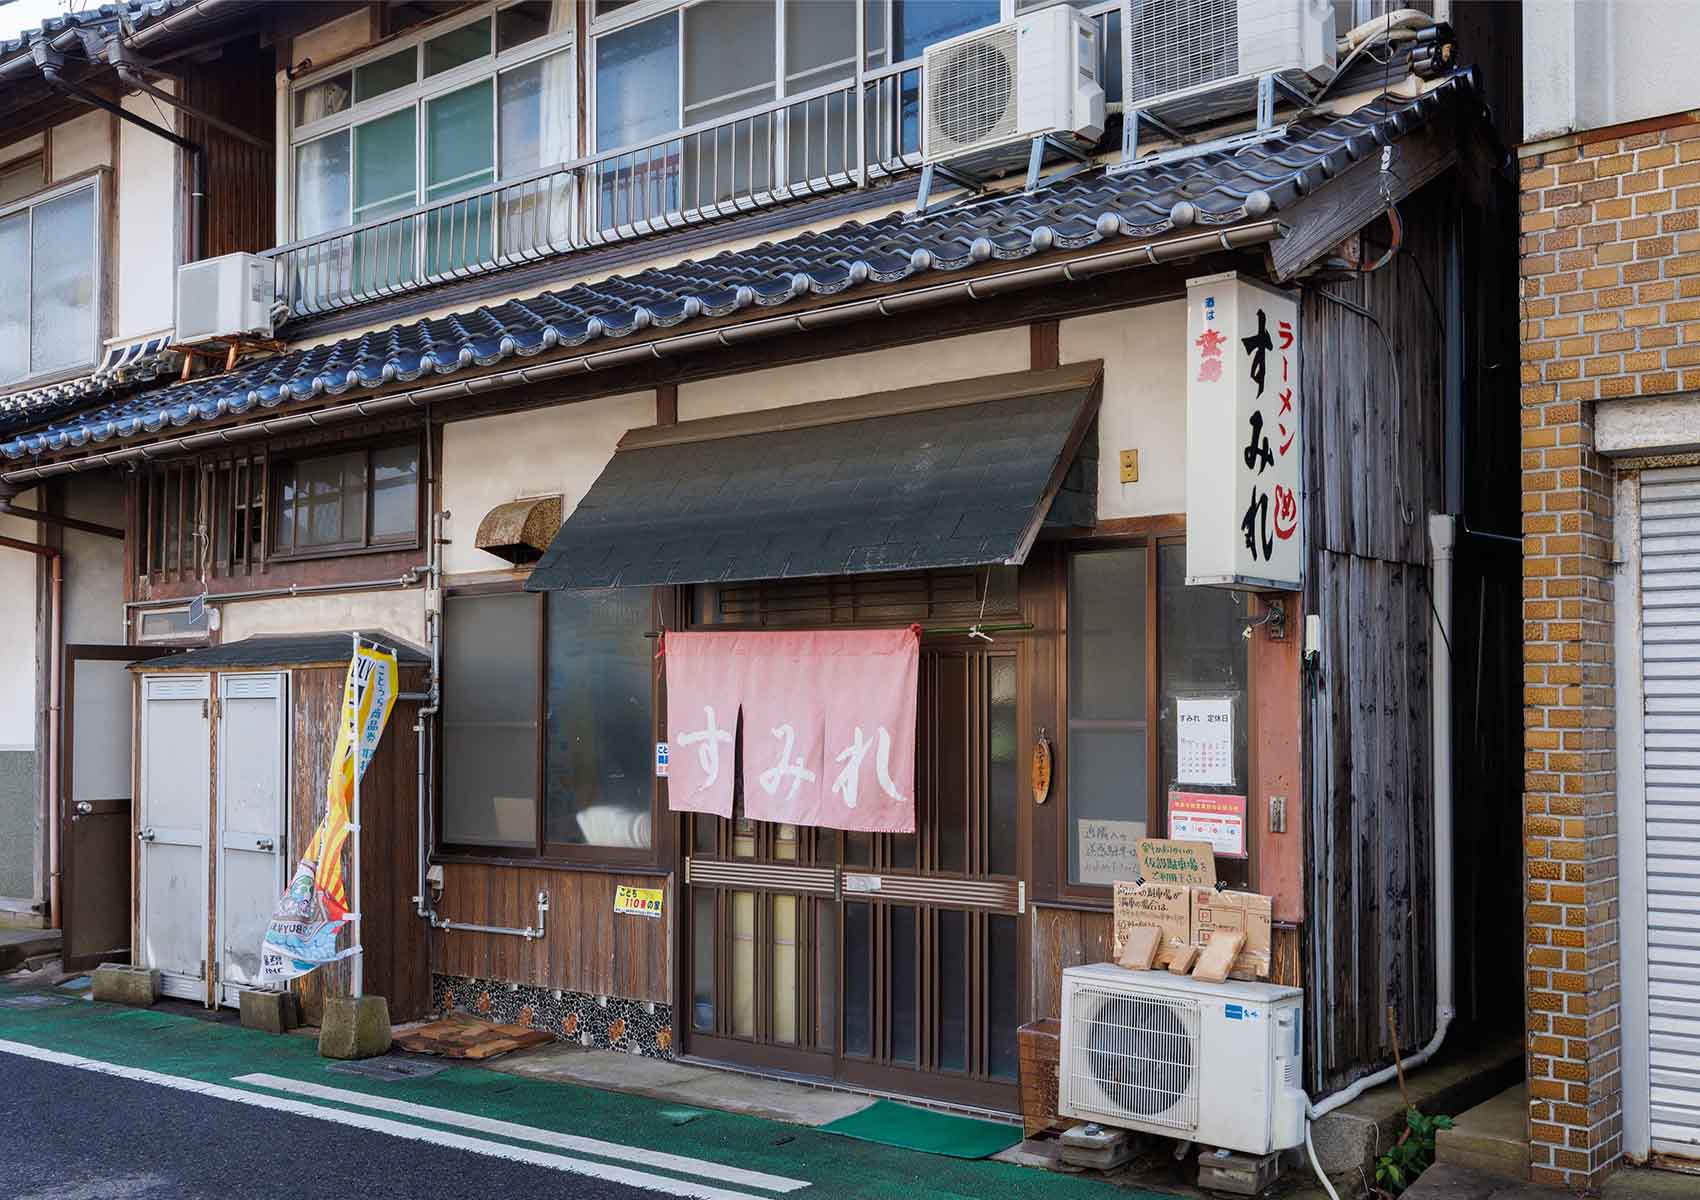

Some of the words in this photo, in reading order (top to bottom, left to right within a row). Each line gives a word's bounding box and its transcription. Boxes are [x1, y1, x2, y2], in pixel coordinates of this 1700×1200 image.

[1240, 308, 1275, 562] すみれ
[1277, 320, 1296, 457] ラーメン
[677, 705, 908, 809] すみれ
[1180, 714, 1201, 722] すみれ
[1207, 714, 1229, 722] 定休日
[619, 888, 638, 898] こども
